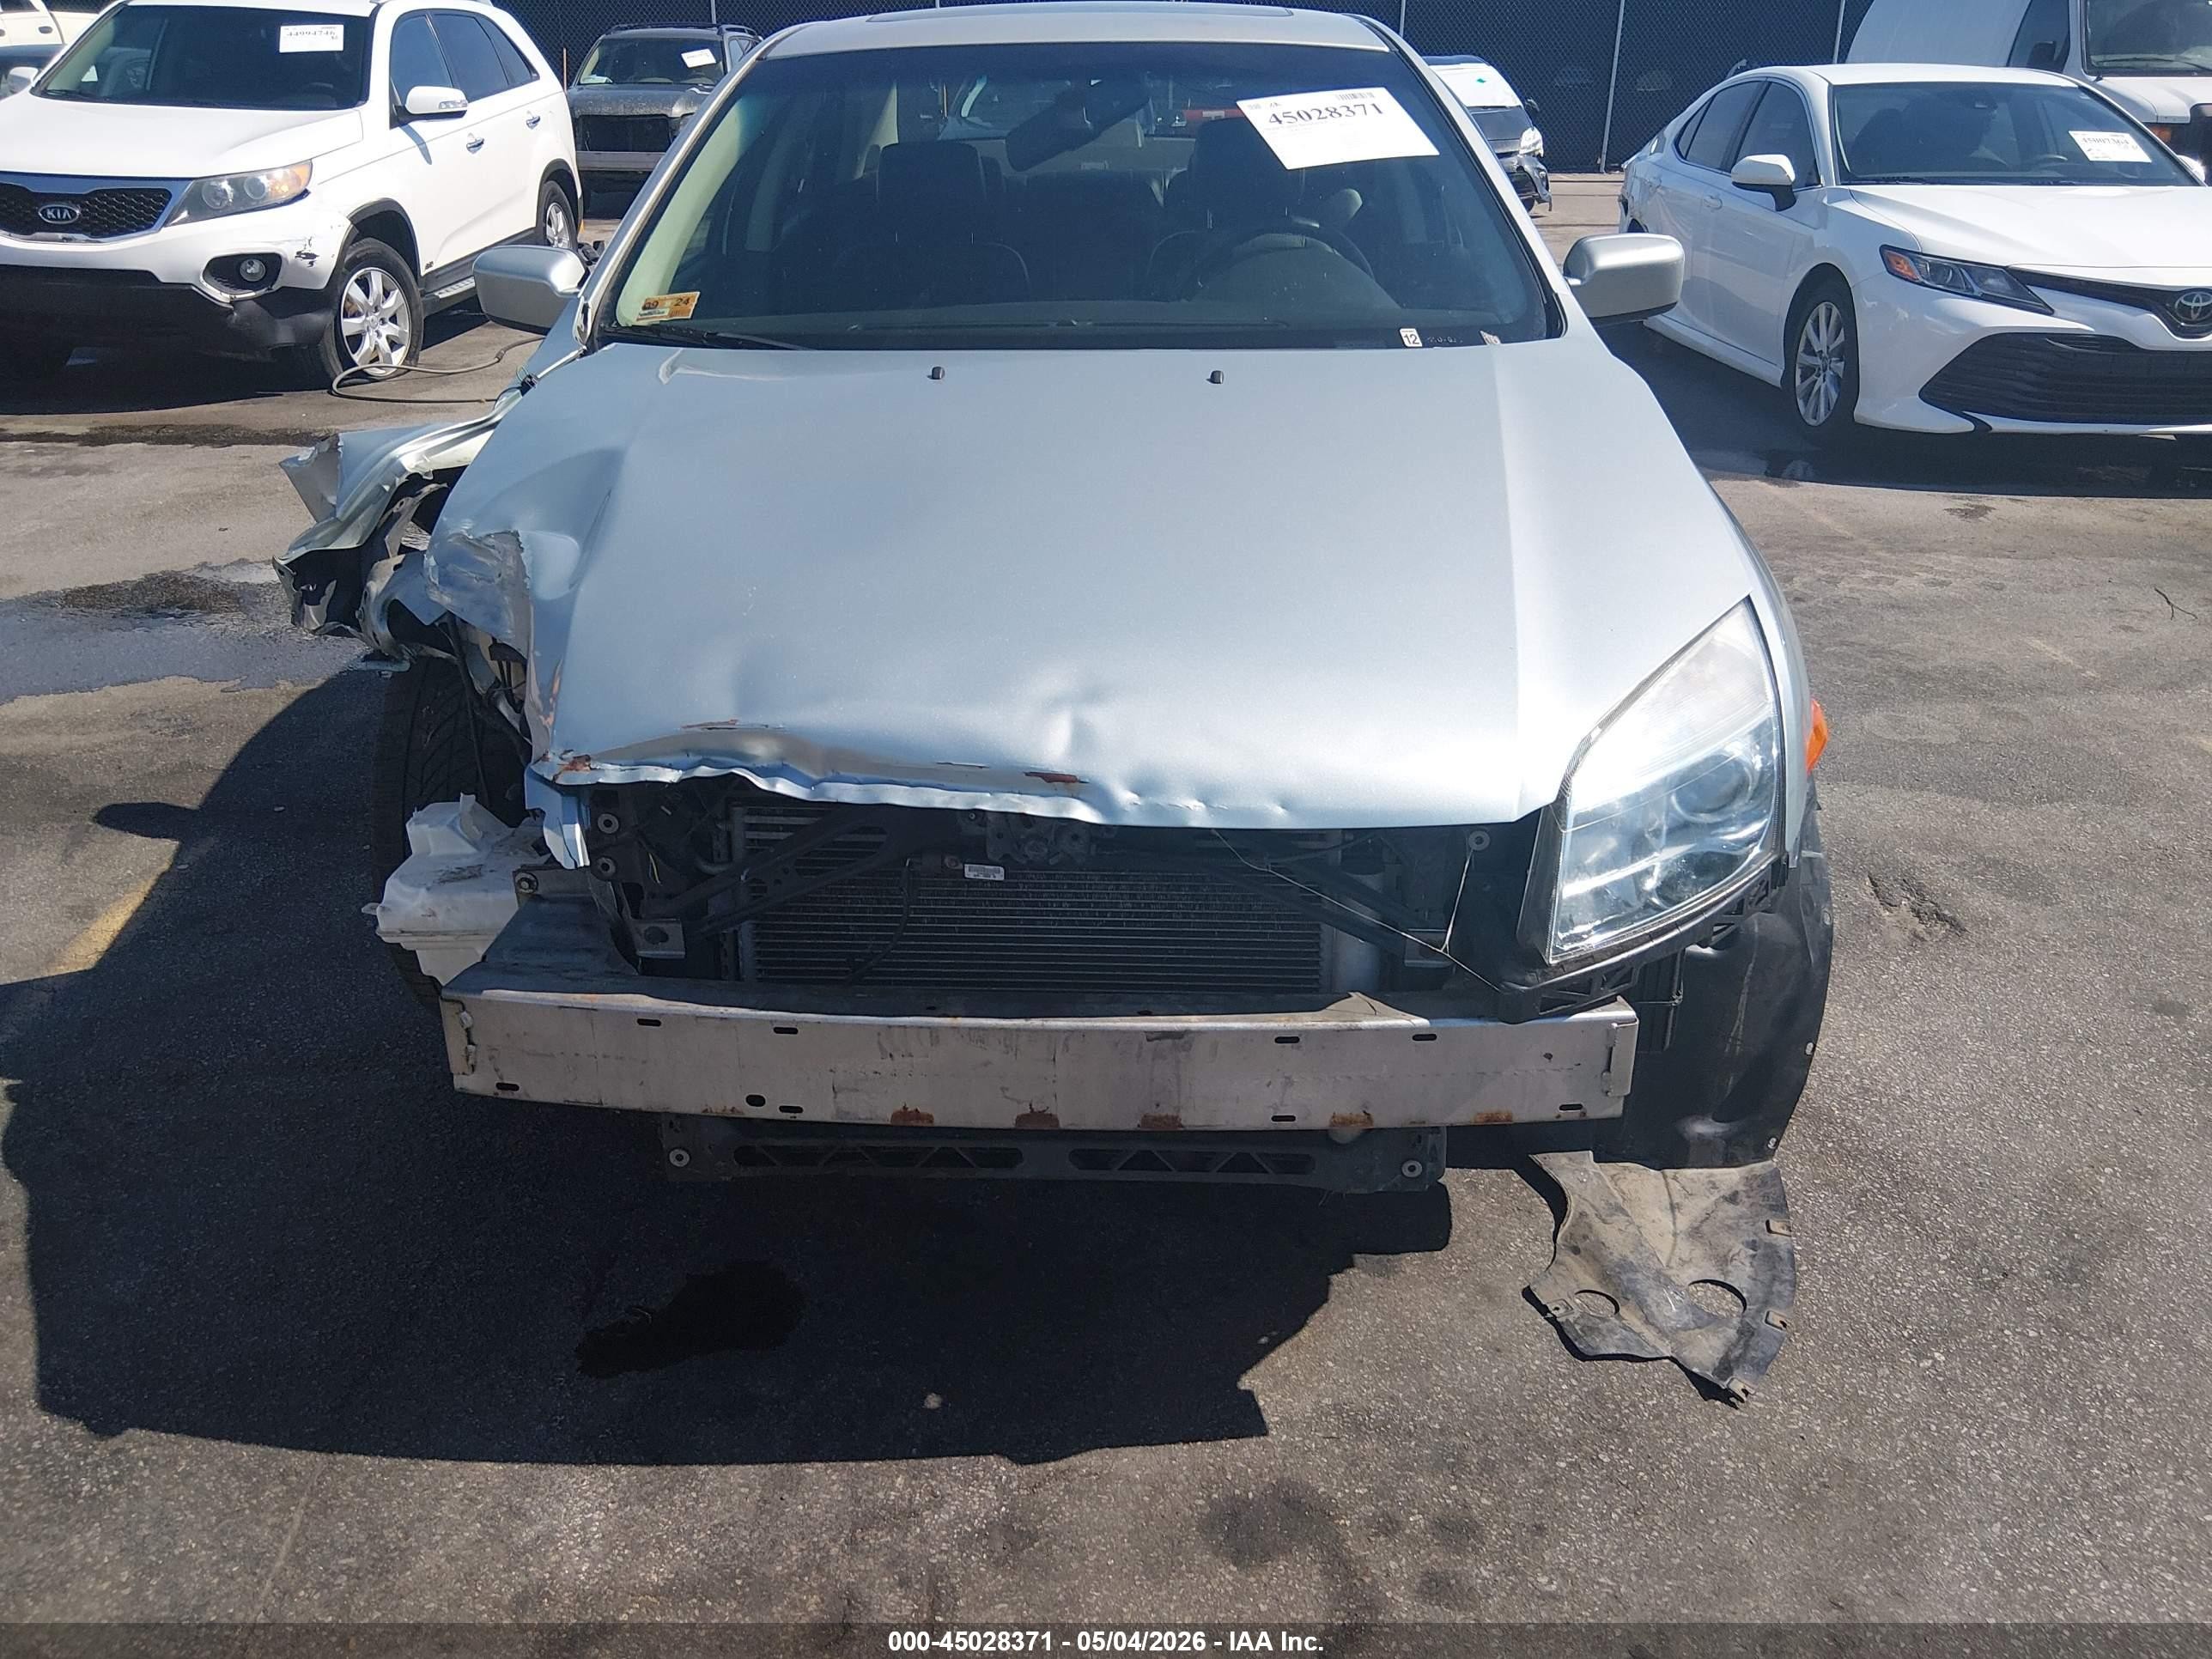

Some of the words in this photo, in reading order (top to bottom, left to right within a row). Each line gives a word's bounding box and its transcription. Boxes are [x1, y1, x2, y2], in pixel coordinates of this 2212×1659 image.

[1268, 102, 1383, 125] 45028371
[46, 208, 72, 220] KIA
[673, 298, 690, 307] 24
[1403, 334, 1420, 345] 12
